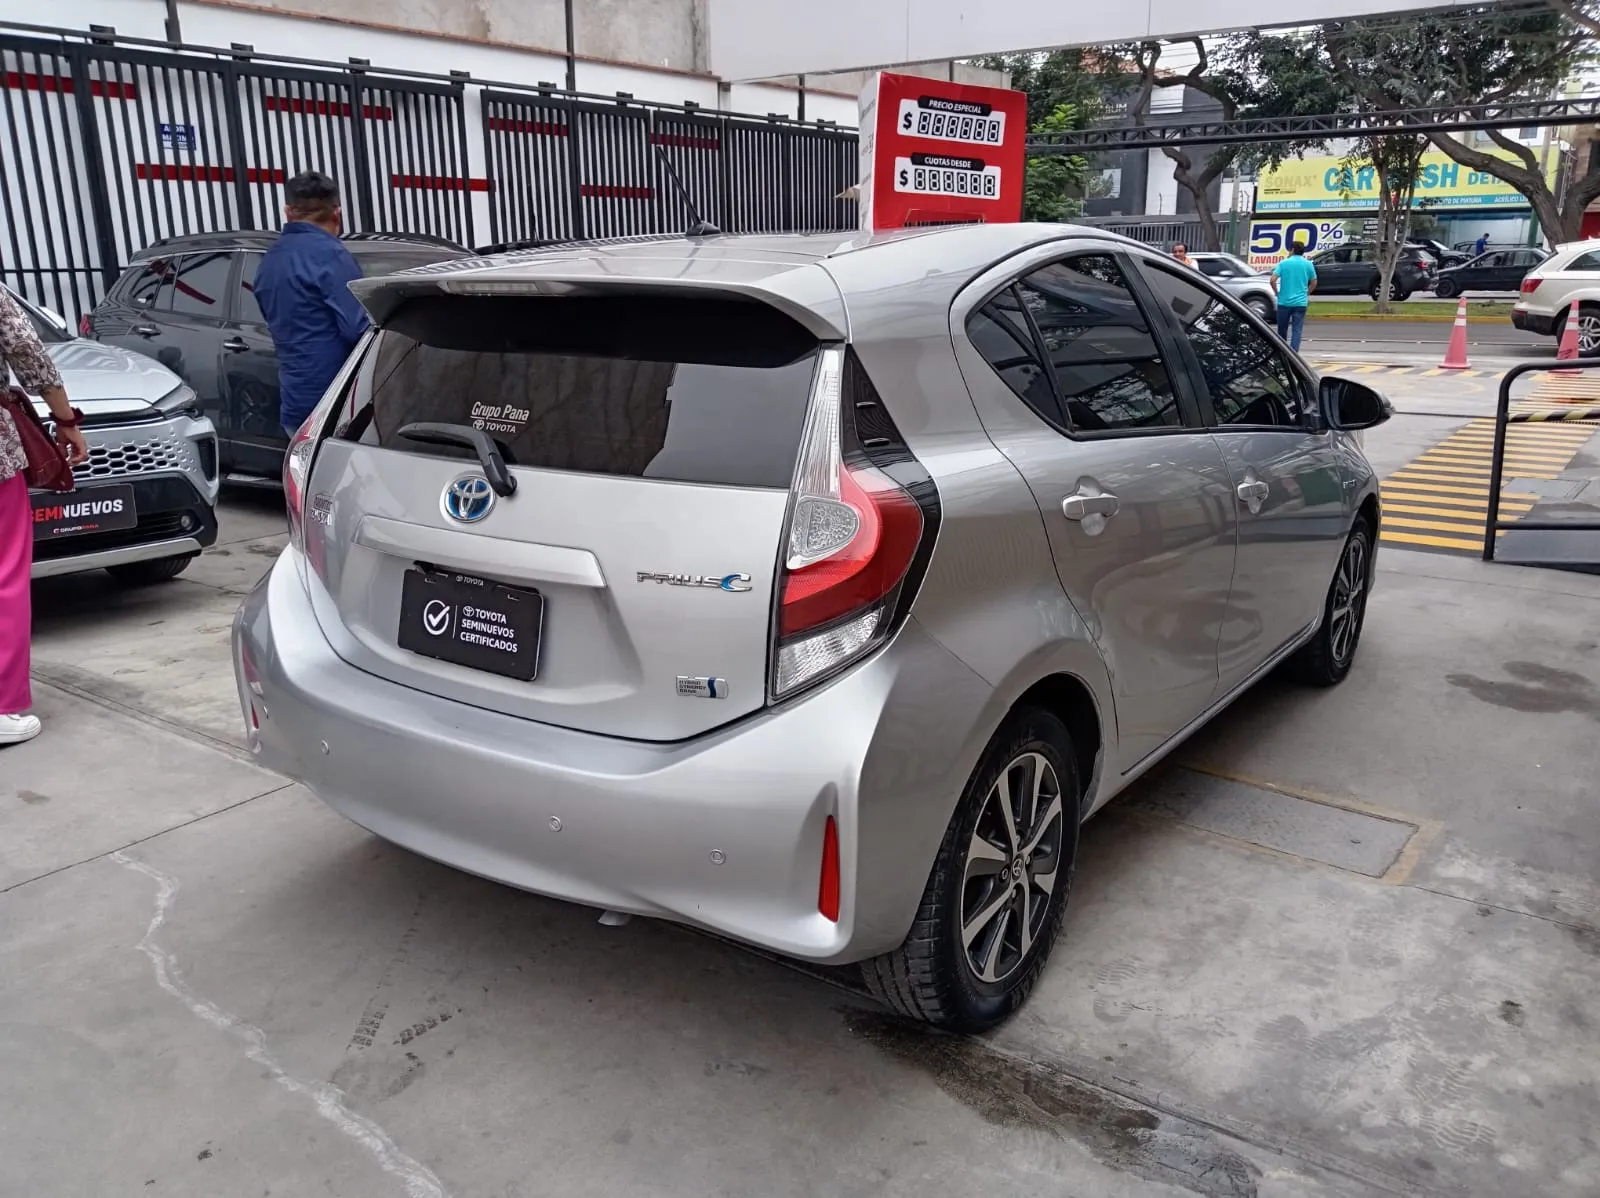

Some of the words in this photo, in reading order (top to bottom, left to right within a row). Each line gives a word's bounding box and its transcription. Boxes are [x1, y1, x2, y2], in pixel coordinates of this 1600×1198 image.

[928, 100, 953, 111] PRECIO
[954, 102, 982, 114] ESPECIAL
[902, 111, 913, 130] $
[924, 156, 949, 166] CUOTAS
[950, 158, 972, 169] DESDE
[899, 169, 909, 187] $
[1323, 165, 1375, 192] CAR
[1250, 222, 1343, 254] 50%
[471, 401, 501, 420] Grupo
[502, 404, 530, 421] Pana
[486, 422, 516, 433] TOYOTA
[463, 576, 484, 587] TOYOTA
[475, 608, 507, 625] TOYOTA
[461, 618, 515, 639] SEMINUEVOS
[460, 631, 518, 653] CERTIFICADOS
